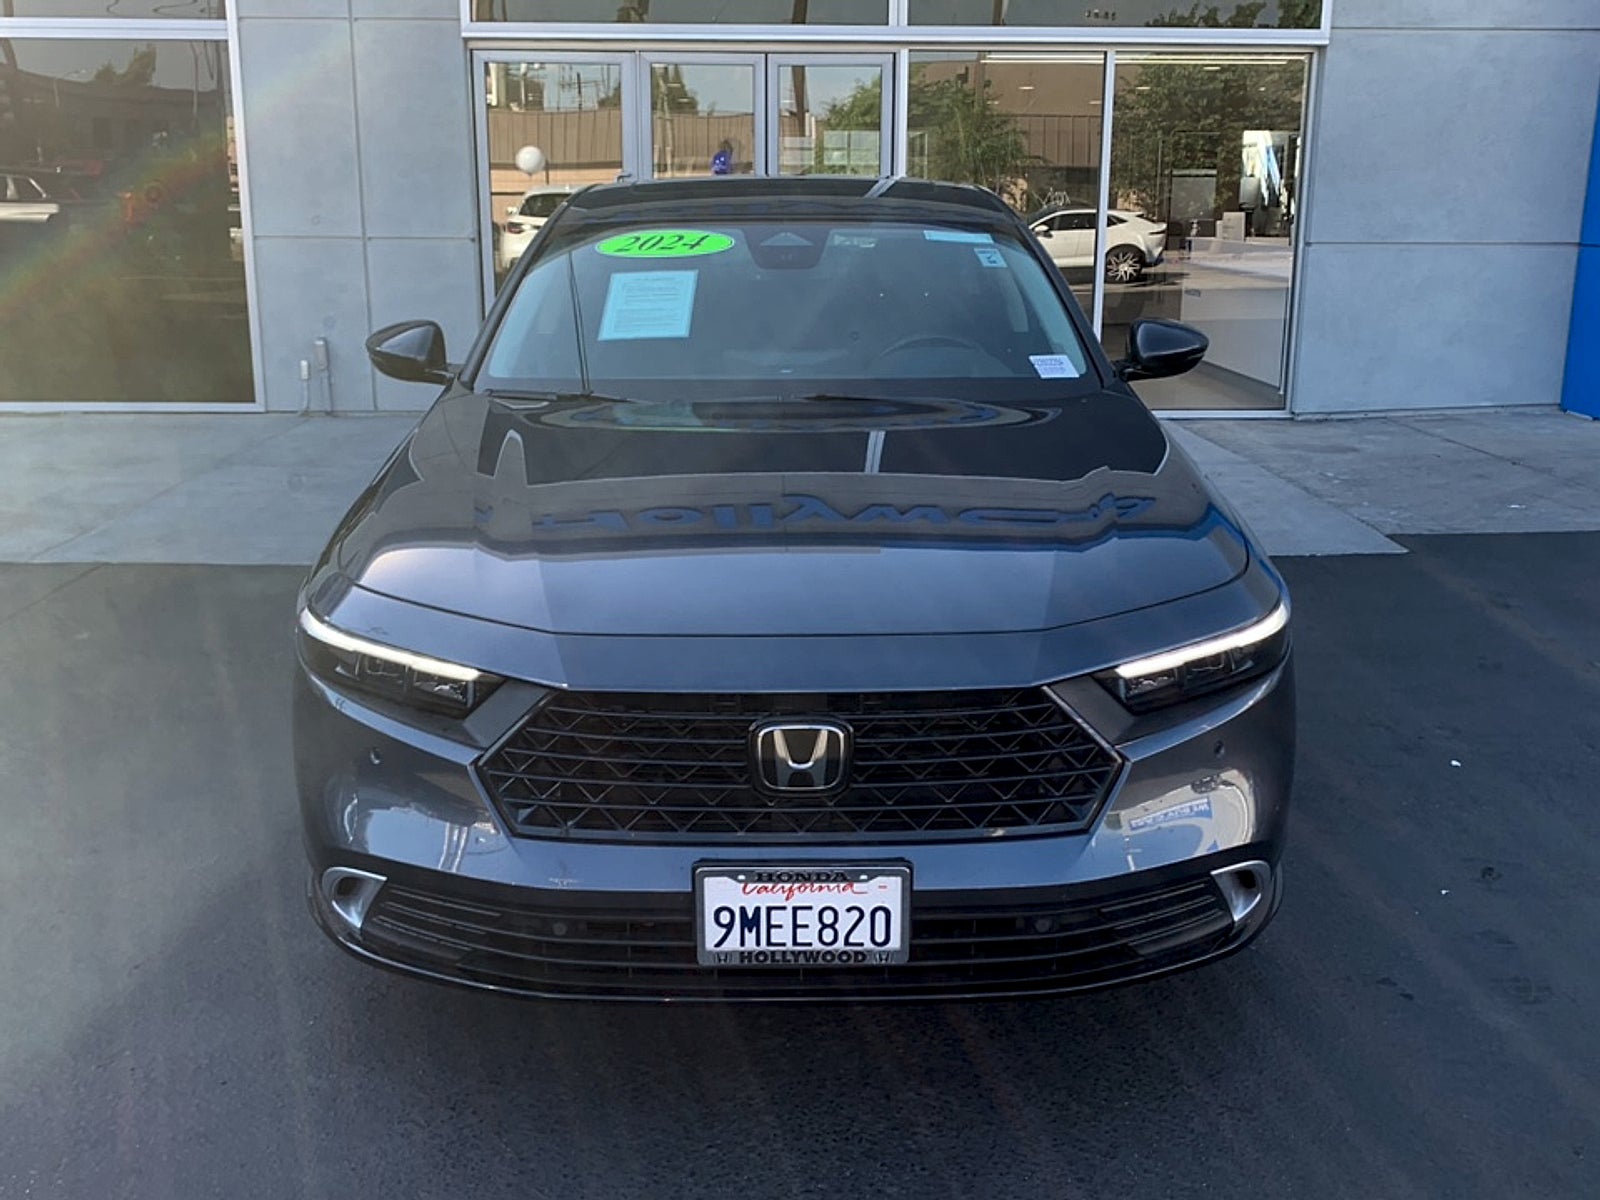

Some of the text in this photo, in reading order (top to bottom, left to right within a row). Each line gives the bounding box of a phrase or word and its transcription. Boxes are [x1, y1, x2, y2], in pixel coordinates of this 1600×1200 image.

[614, 234, 710, 253] 2024
[754, 871, 849, 883] HONDA
[742, 882, 867, 901] California
[713, 905, 892, 948] 9MEE820
[739, 951, 867, 963] HOLLYWOOD
